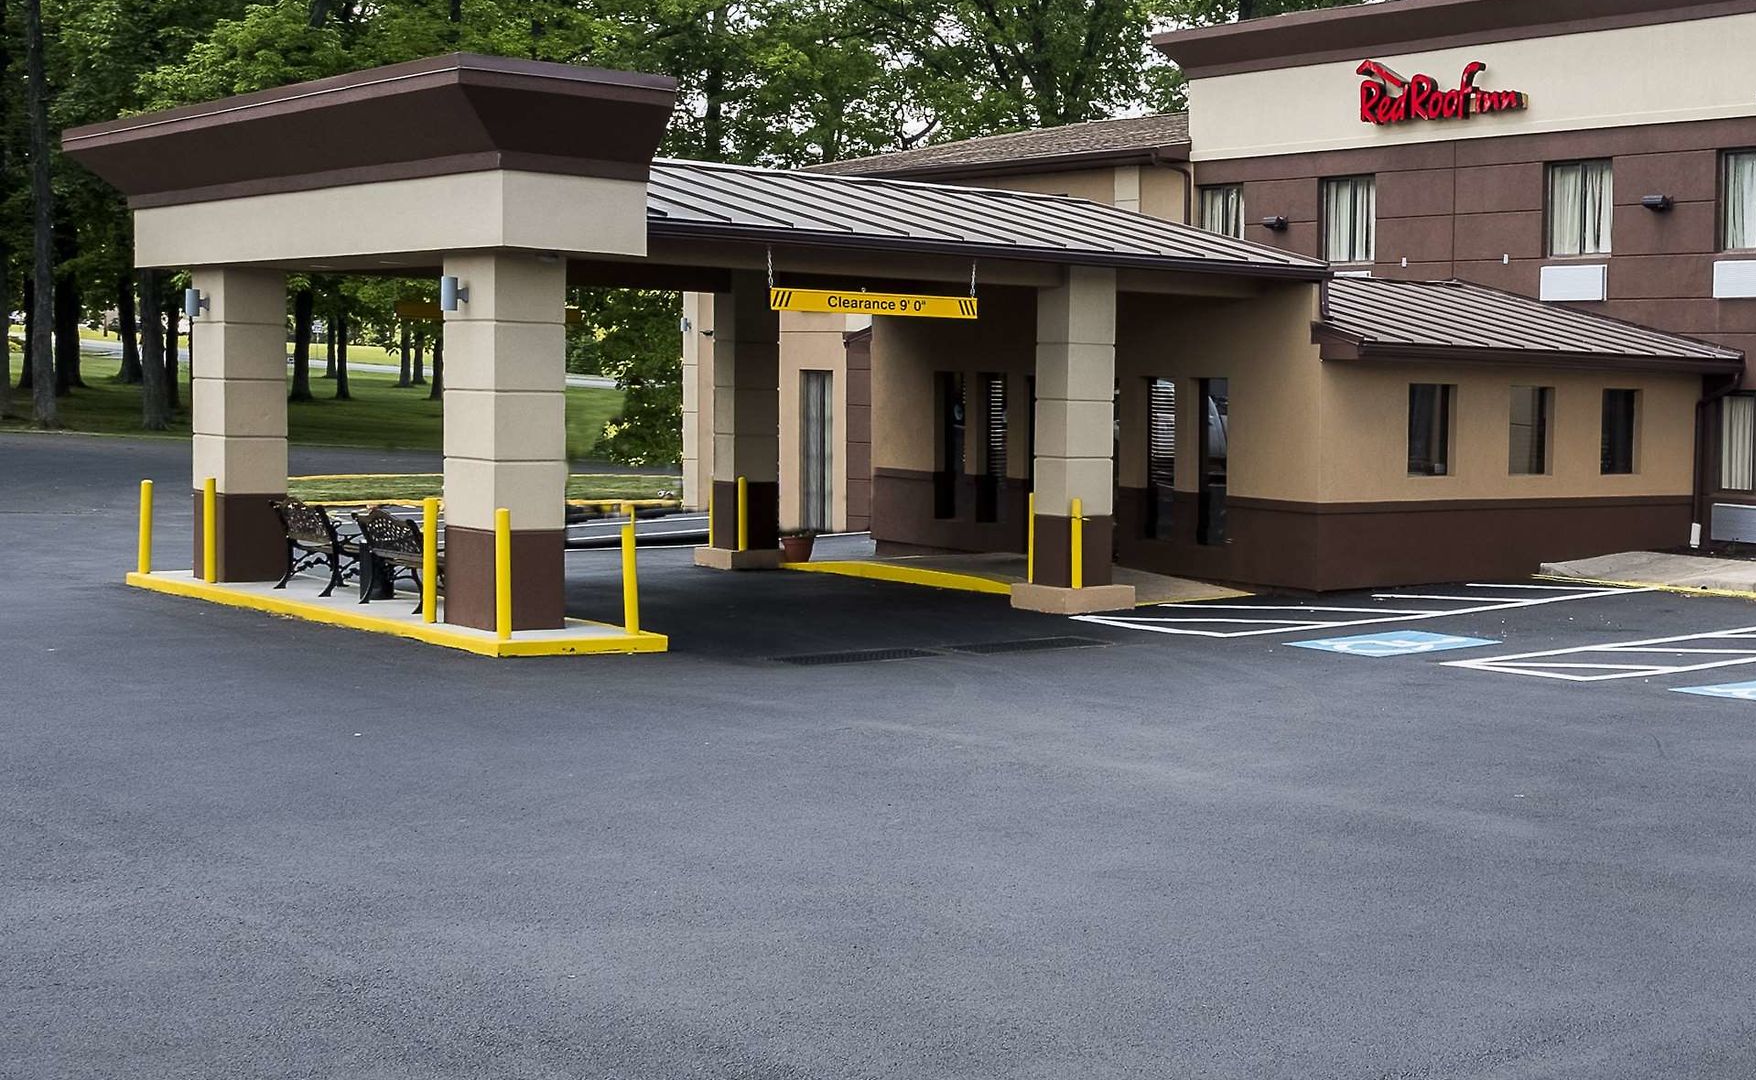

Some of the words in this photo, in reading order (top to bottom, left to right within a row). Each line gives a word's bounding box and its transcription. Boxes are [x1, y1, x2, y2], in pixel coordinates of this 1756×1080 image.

[1358, 72, 1410, 125] Red
[1410, 61, 1487, 121] Roof
[827, 295, 896, 311] Clearance
[899, 299, 911, 312] 9'
